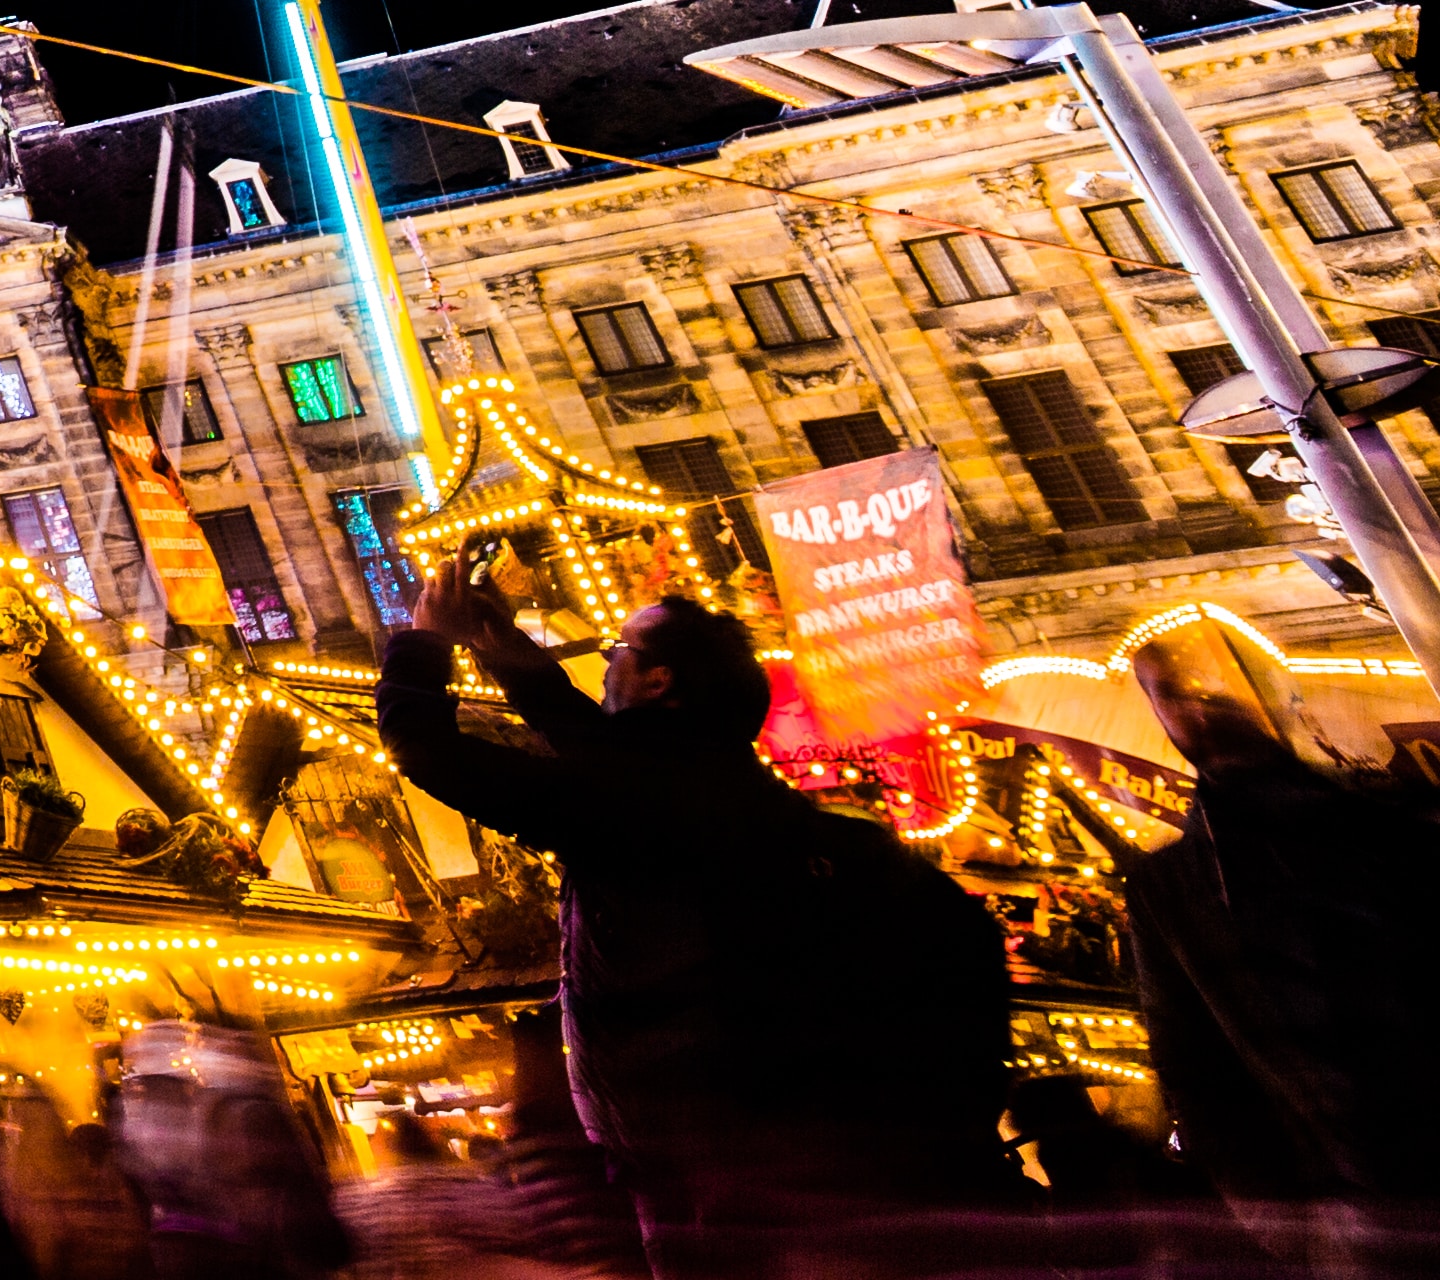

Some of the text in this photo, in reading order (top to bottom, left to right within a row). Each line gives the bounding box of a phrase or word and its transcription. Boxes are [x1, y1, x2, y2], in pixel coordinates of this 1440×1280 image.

[770, 478, 932, 544] BAR-B-QUE
[813, 549, 914, 592] STEAKS
[794, 579, 954, 637] BRATWURST
